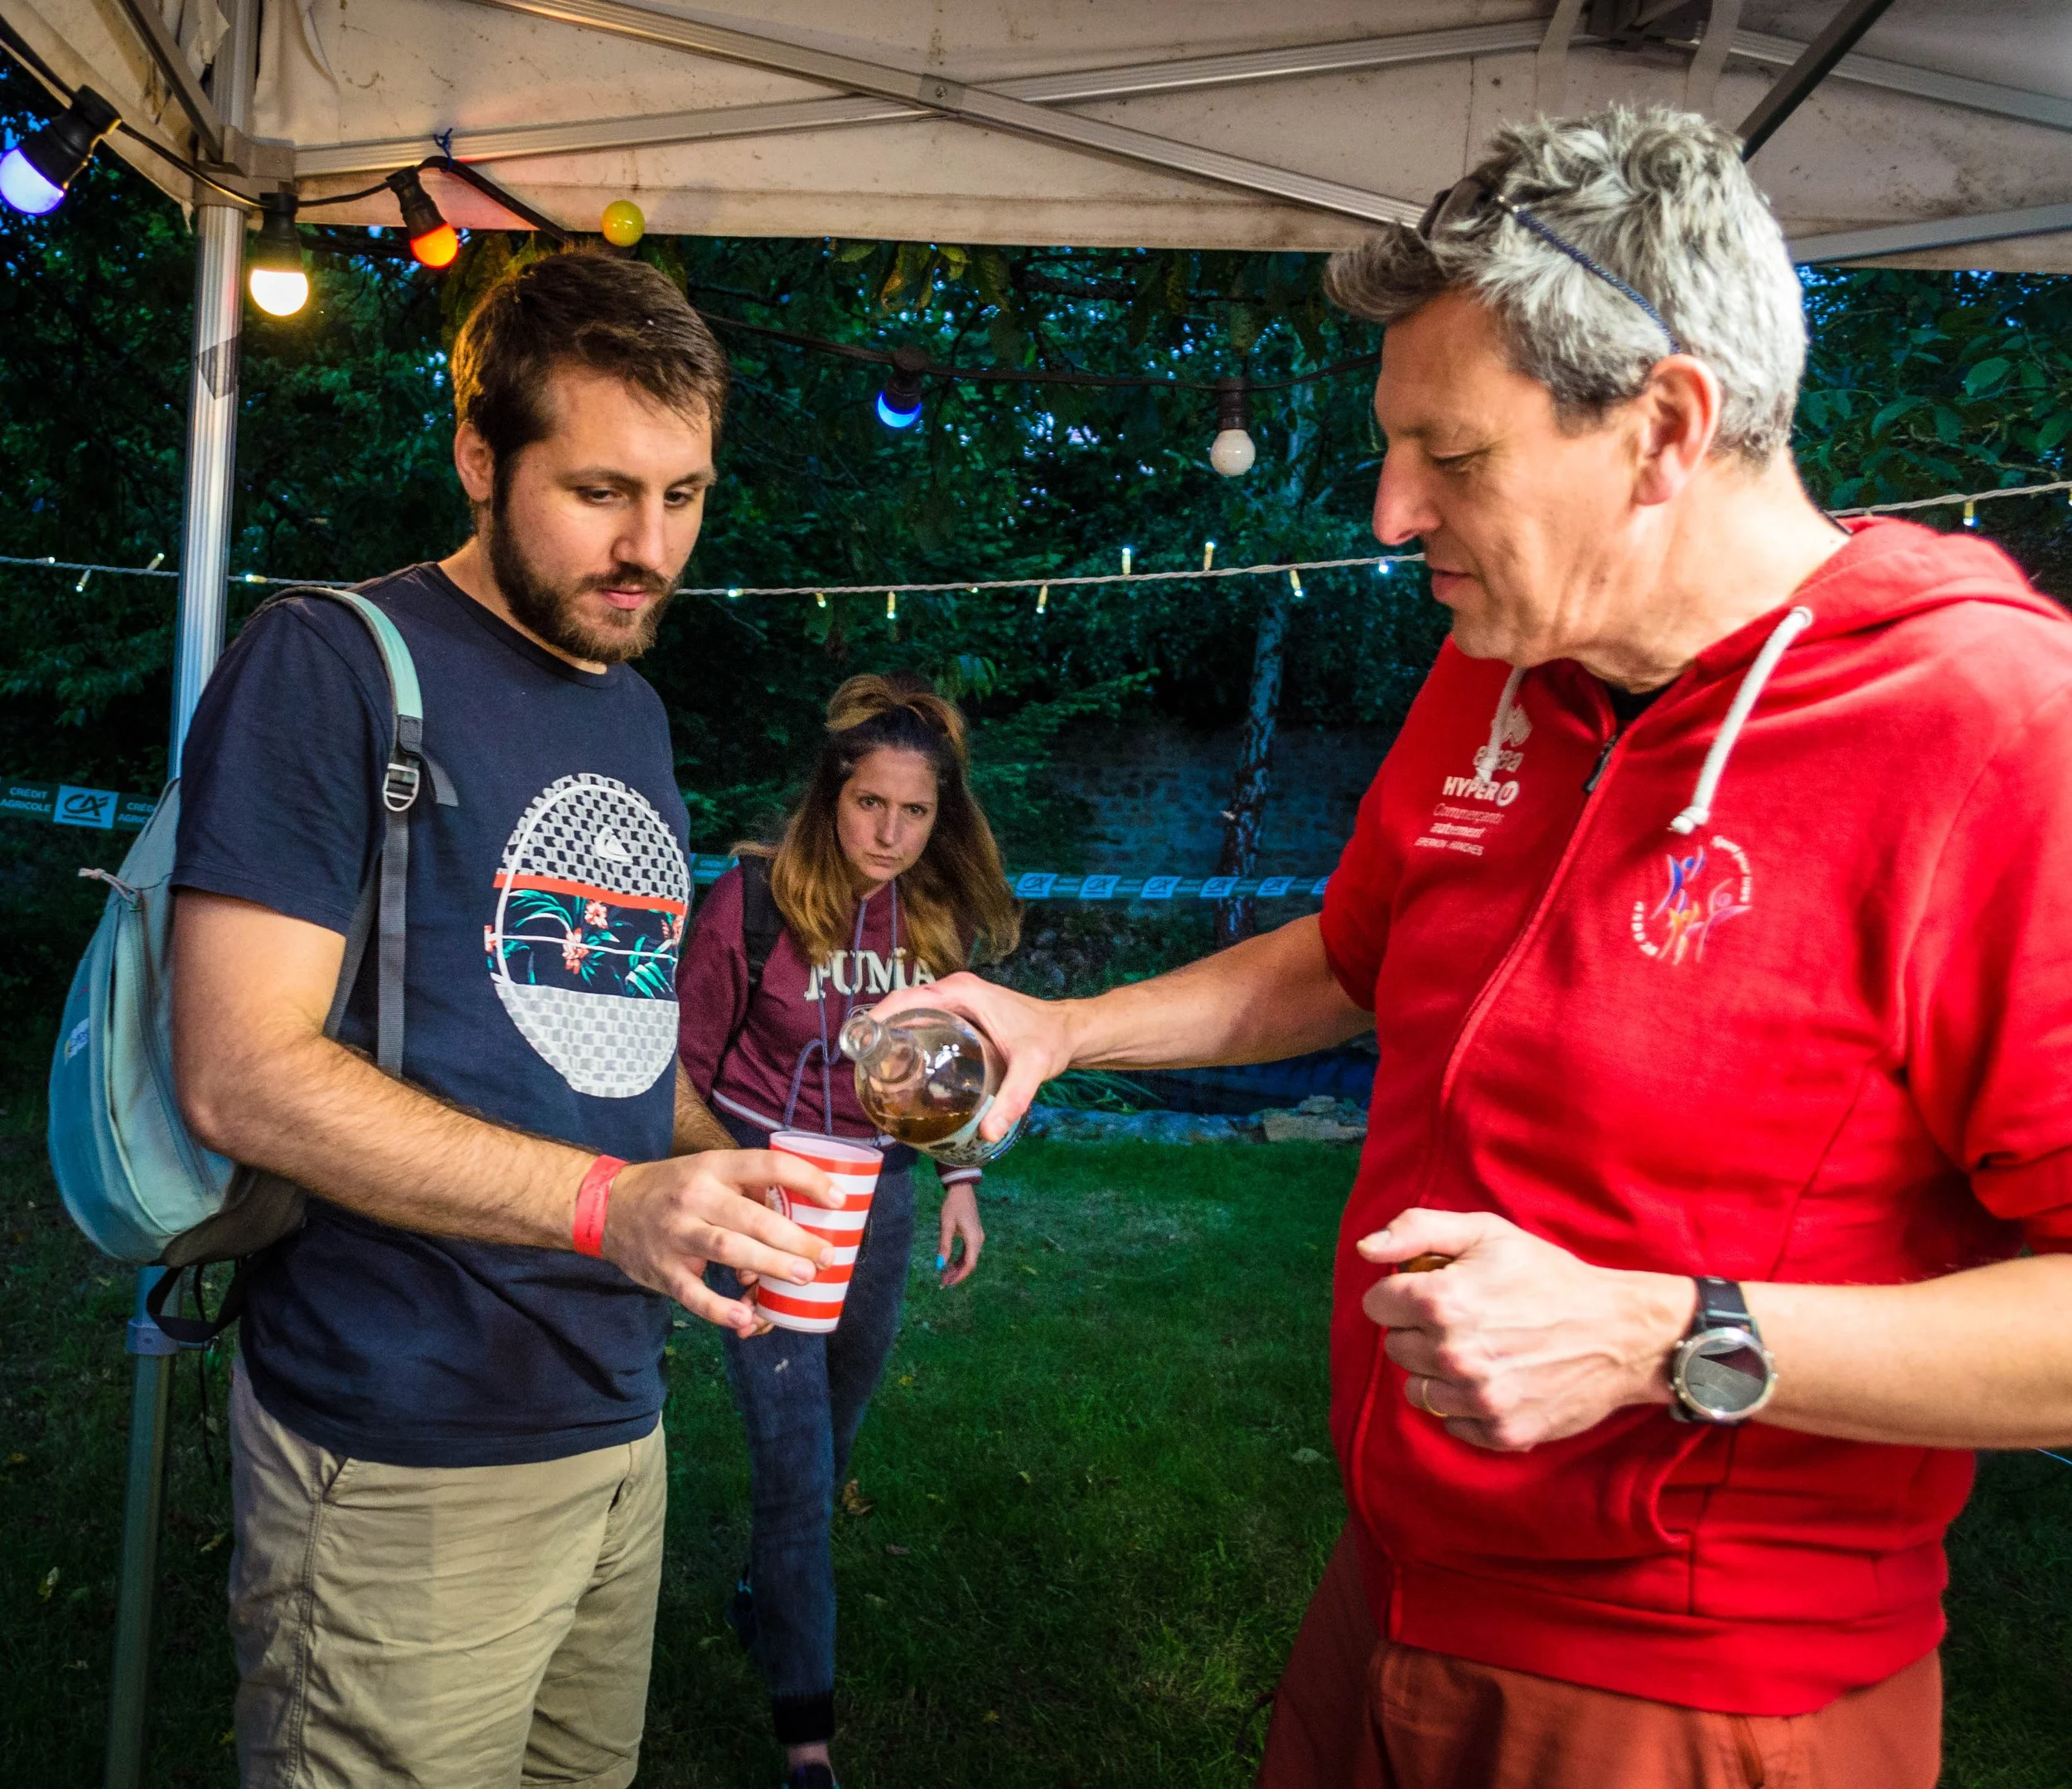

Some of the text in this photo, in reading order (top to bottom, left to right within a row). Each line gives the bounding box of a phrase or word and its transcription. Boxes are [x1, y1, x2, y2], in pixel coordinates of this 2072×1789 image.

[1441, 776, 1498, 802] HYPER
[0, 798, 52, 812] AGRICOLE
[803, 948, 937, 1001] PUMA
